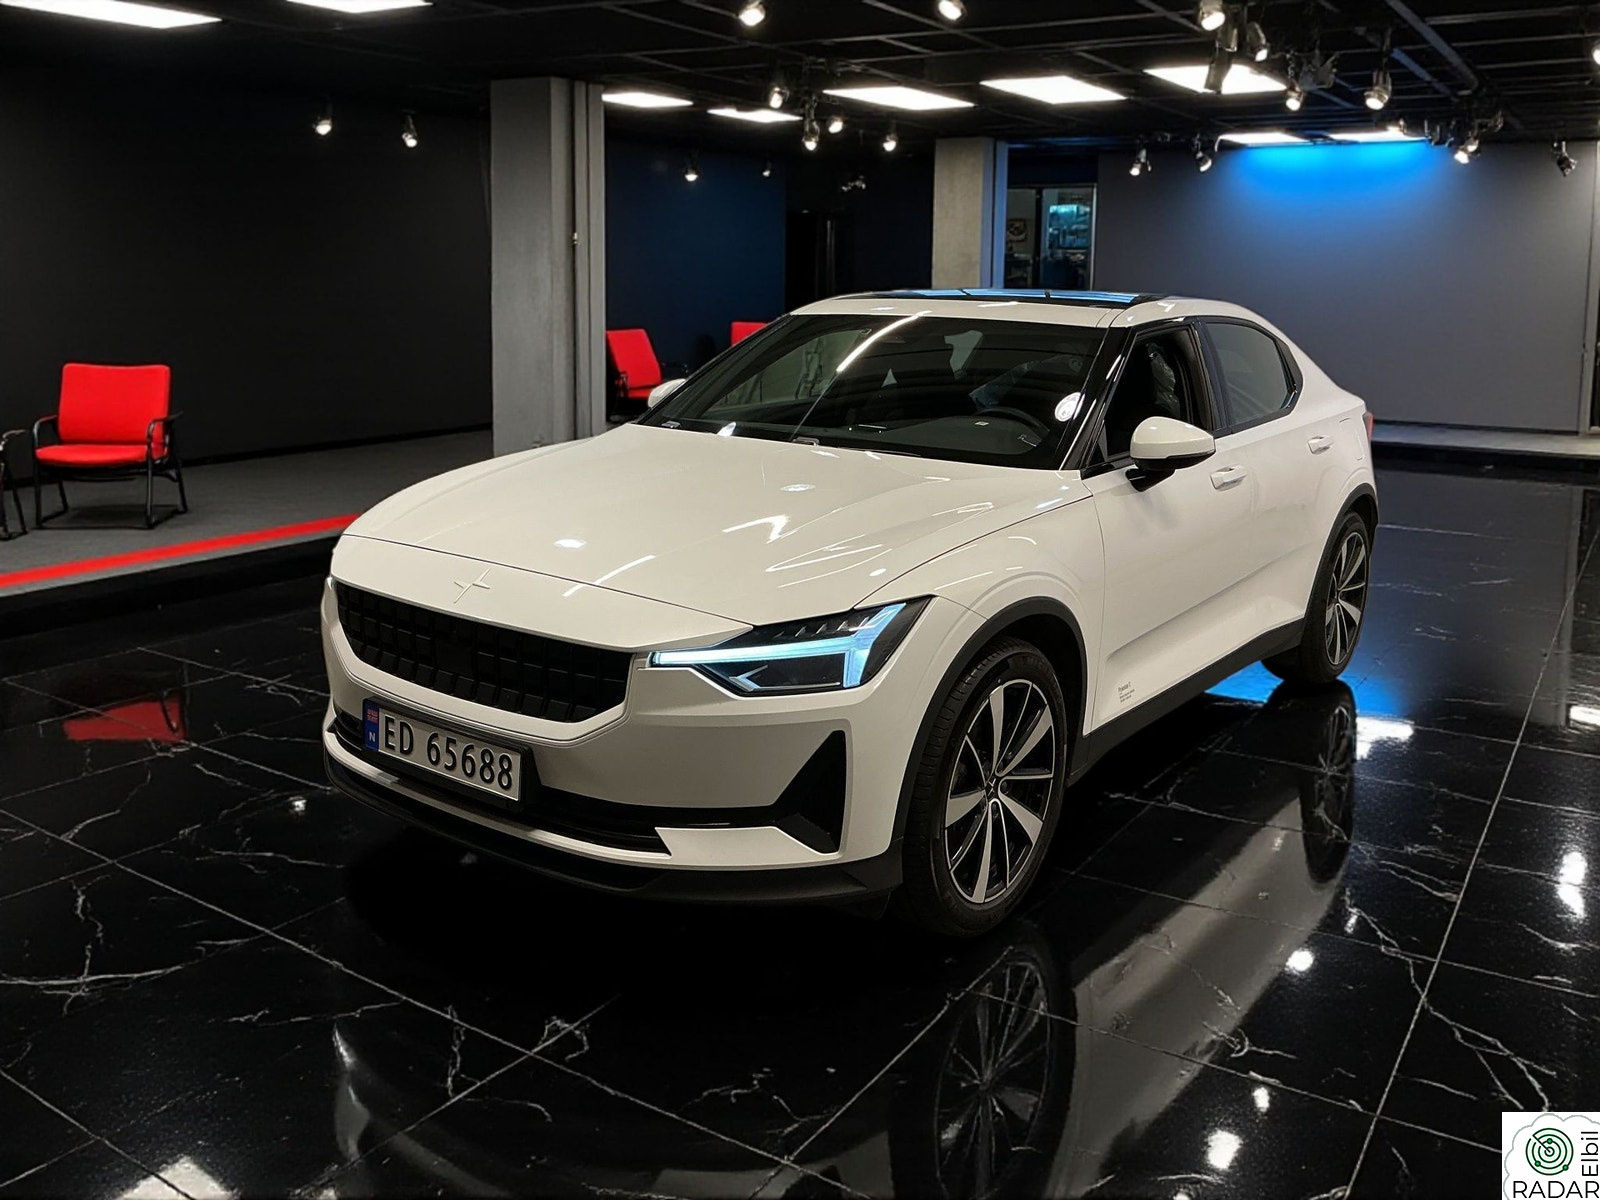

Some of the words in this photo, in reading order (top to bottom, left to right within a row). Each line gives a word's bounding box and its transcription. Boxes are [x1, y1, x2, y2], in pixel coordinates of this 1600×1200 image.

[368, 731, 376, 743] N
[384, 714, 414, 755] ED
[427, 732, 513, 790] 65688
